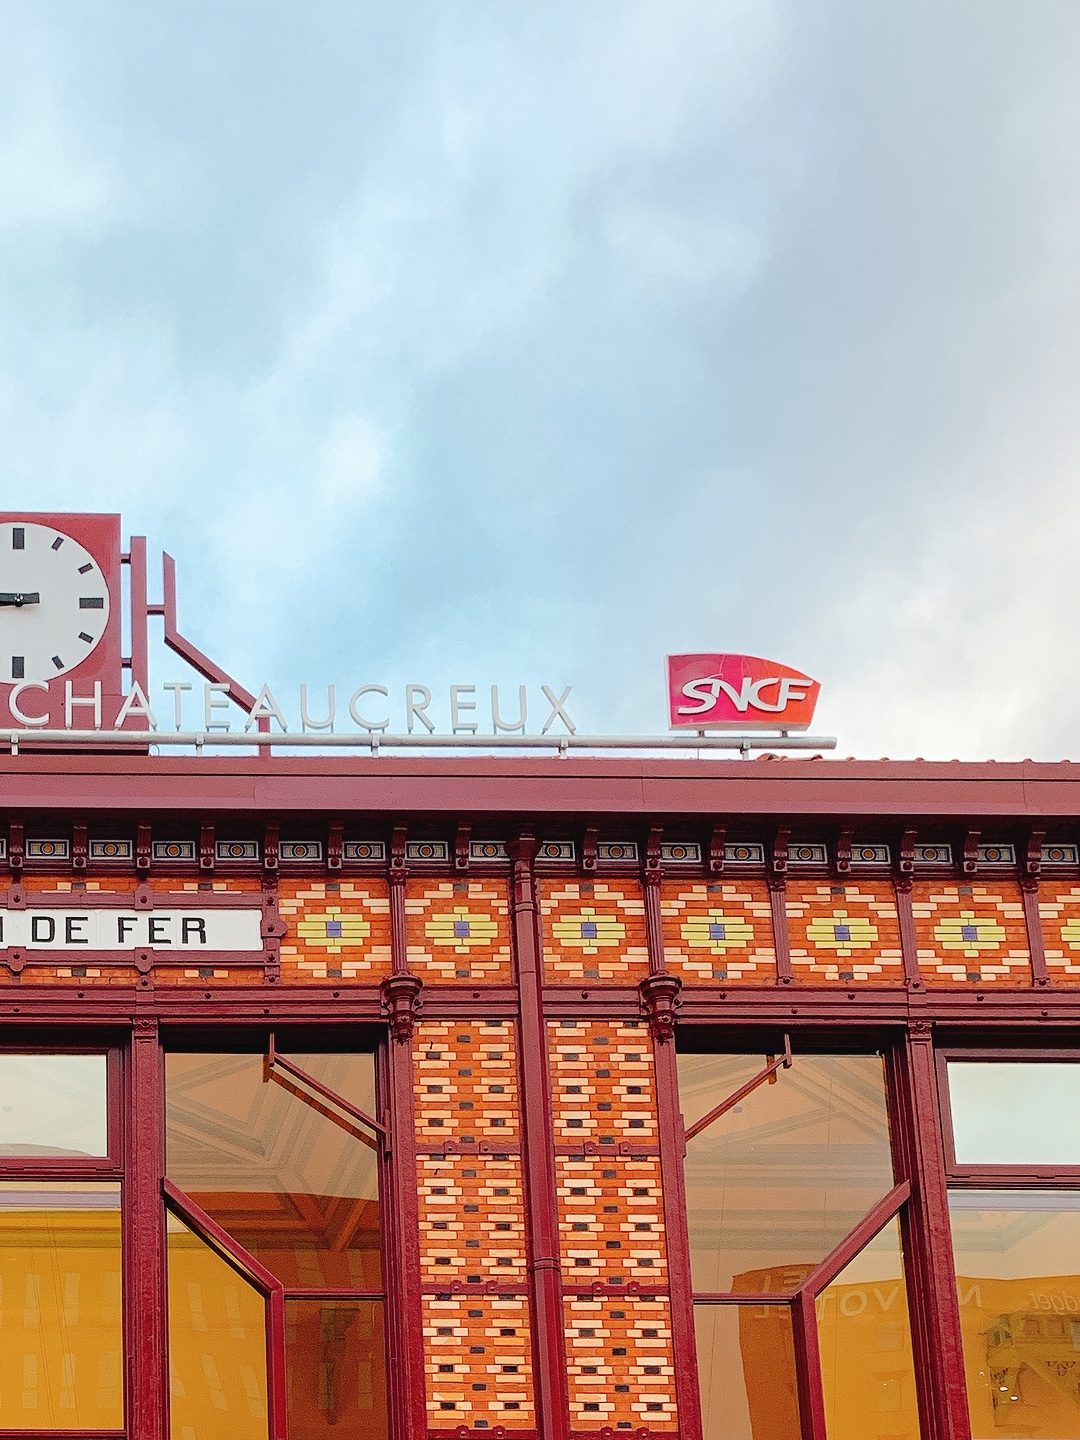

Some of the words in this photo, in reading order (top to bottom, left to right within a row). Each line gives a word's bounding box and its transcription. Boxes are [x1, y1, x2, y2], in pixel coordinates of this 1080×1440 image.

[7, 679, 578, 733] CHATEAUCREUX
[677, 674, 814, 714] SNCF
[31, 916, 89, 944] DE
[117, 917, 208, 945] FER
